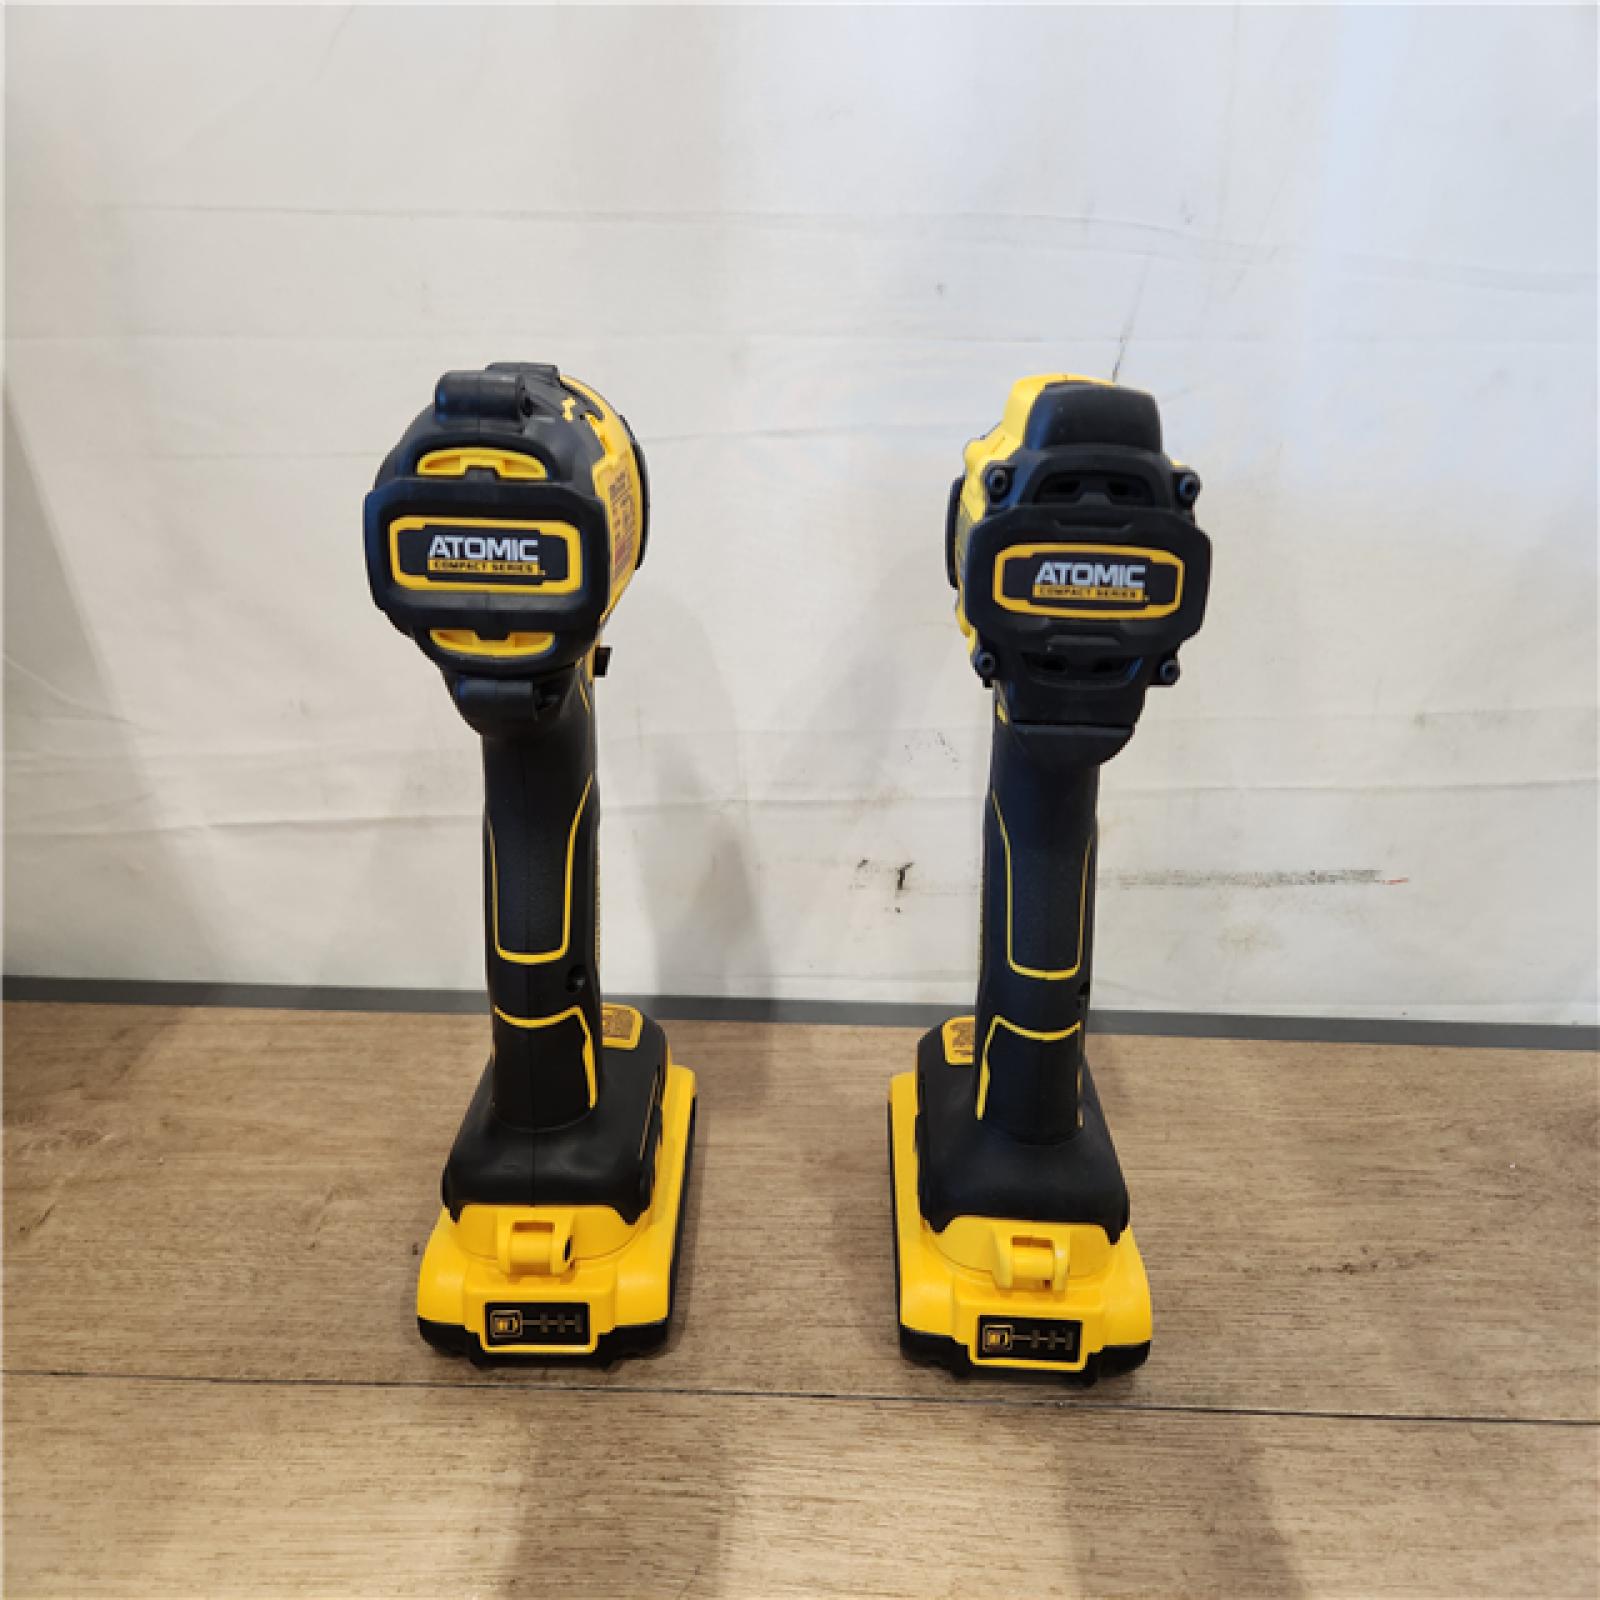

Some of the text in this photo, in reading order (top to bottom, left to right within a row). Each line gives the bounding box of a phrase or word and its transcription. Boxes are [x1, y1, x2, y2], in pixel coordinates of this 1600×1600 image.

[430, 535, 539, 561] ATOMIC
[433, 560, 534, 574] COMPACT SERIES
[1034, 561, 1146, 588] ATOMIC
[1037, 586, 1136, 600] COMPACT SERIES
